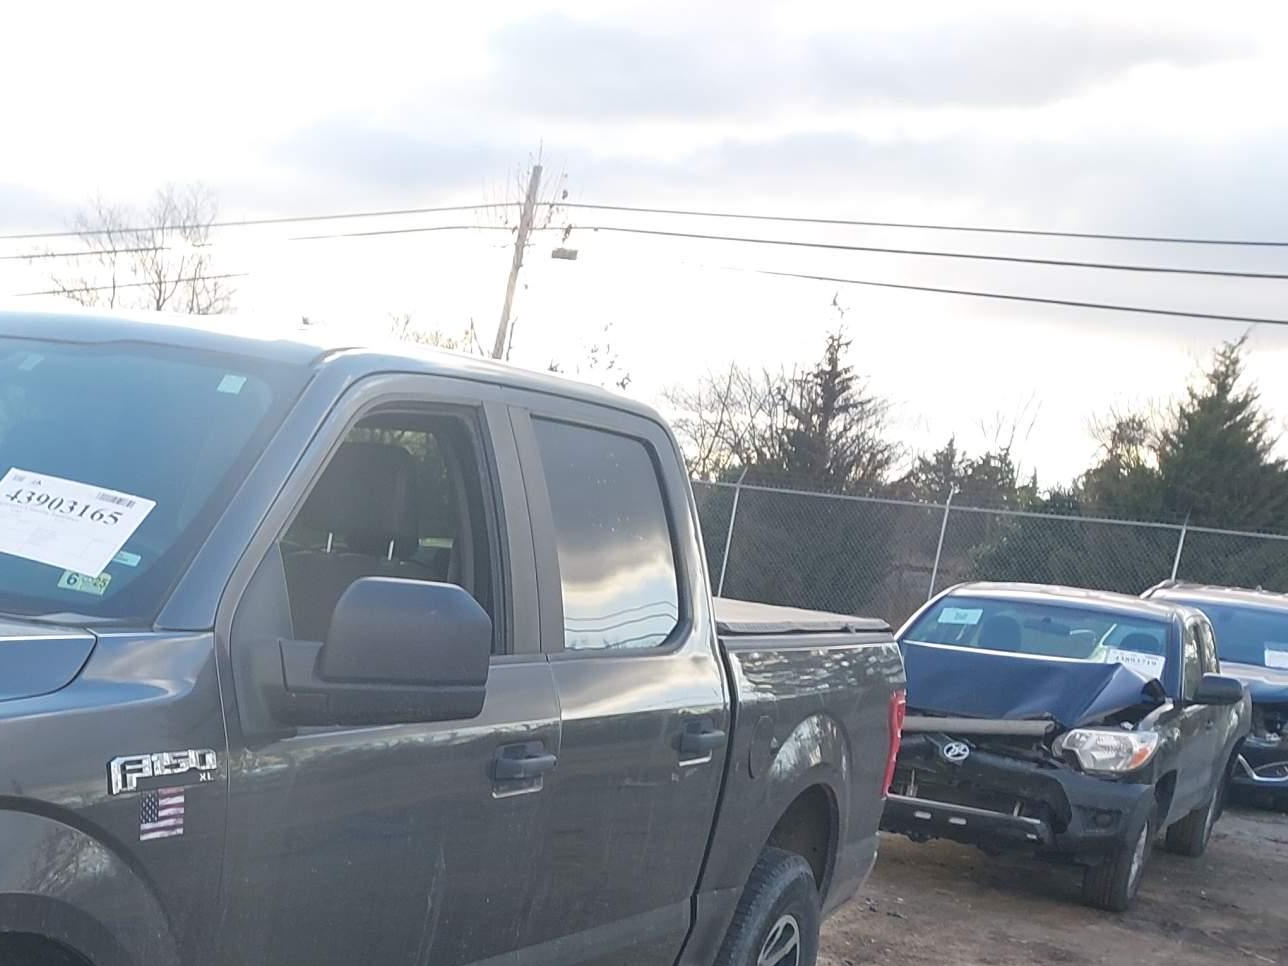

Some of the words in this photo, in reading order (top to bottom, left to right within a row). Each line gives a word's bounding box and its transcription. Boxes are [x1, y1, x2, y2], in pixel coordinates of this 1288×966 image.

[5, 488, 124, 526] 43903165
[66, 572, 80, 586] 6
[199, 771, 215, 783] XL
